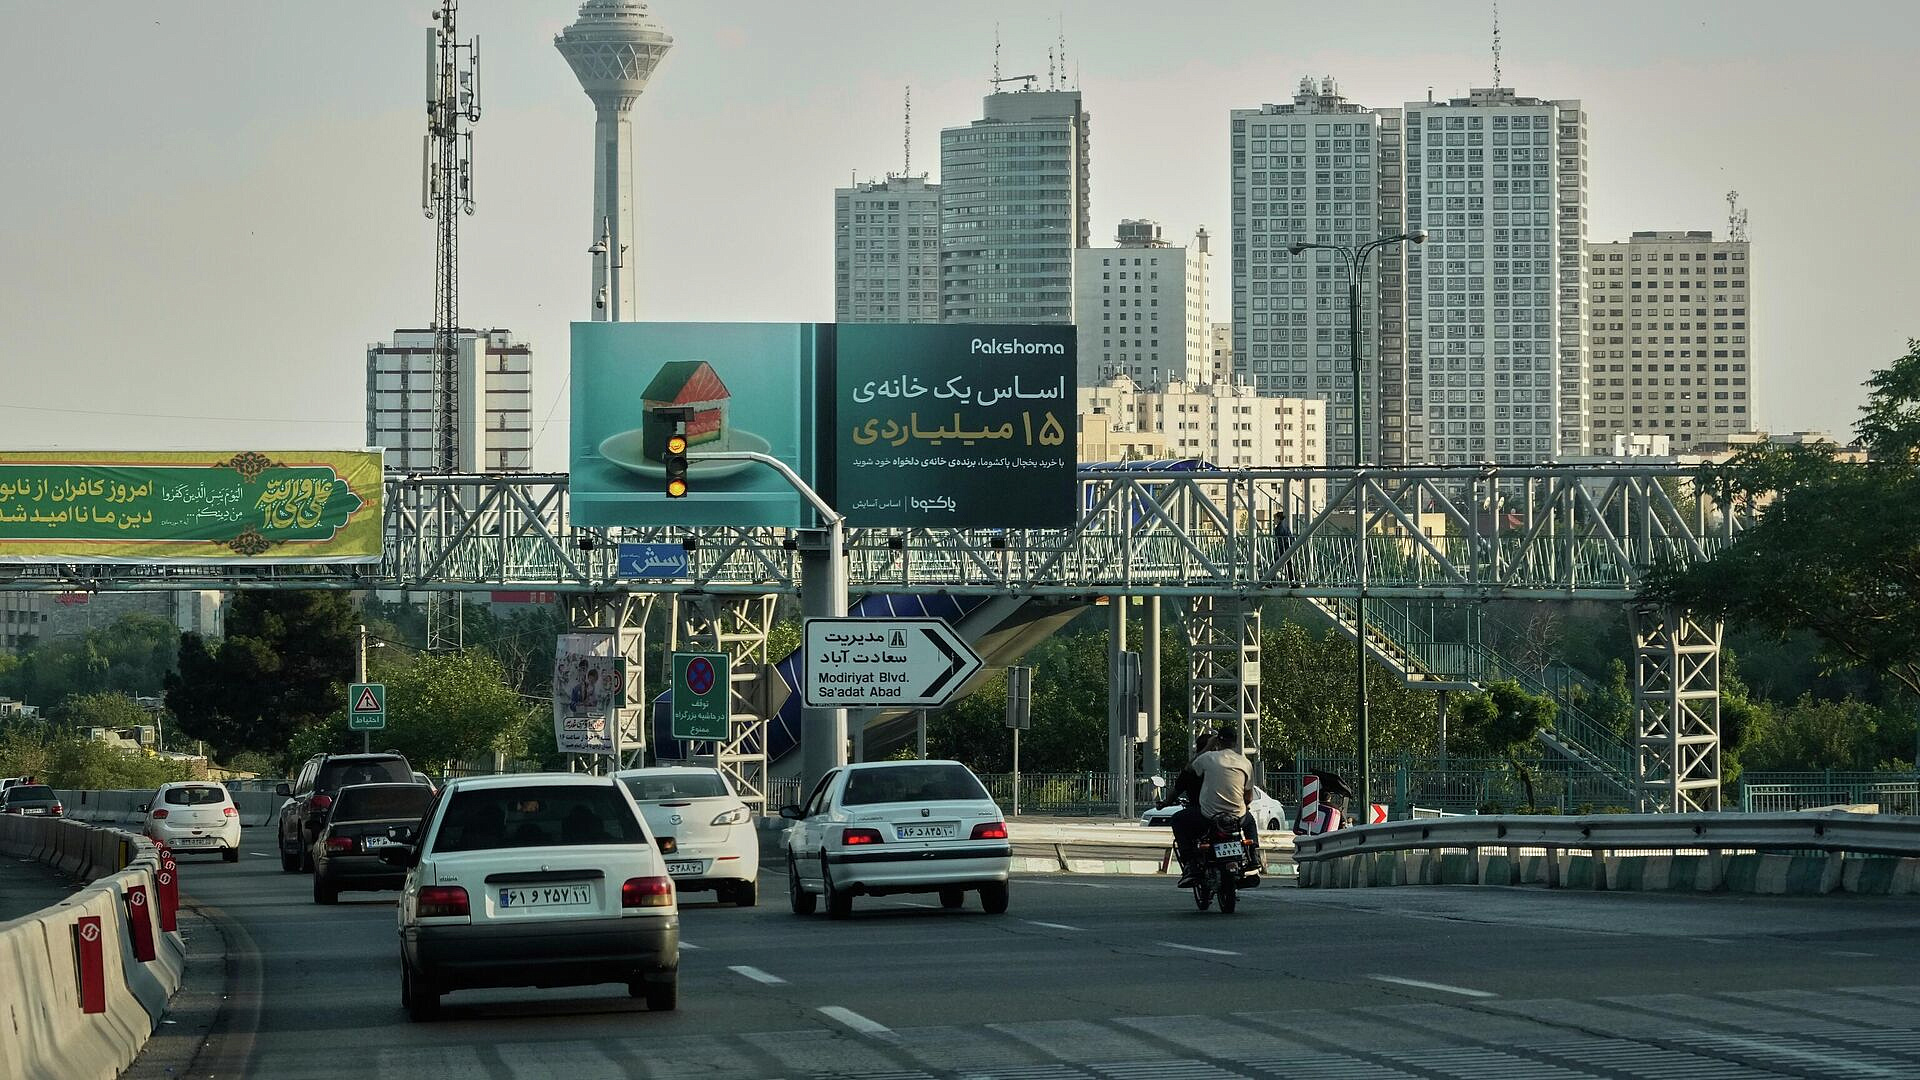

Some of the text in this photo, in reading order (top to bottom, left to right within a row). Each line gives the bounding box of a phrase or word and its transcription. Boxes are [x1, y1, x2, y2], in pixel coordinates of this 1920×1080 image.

[971, 338, 1065, 354] Pakshoma
[933, 375, 971, 404] یک
[977, 375, 1065, 406] اساس
[853, 411, 1065, 447] ۱۵ میلیاردی
[852, 457, 873, 468] شوید
[874, 457, 891, 468] خود
[893, 456, 919, 467] دلخواه
[1011, 457, 1037, 469] یخچال
[1038, 457, 1057, 469] خرید
[1057, 457, 1065, 468] با
[32, 478, 48, 502] از
[51, 477, 105, 502] کافران
[105, 479, 153, 503] امروز
[852, 498, 901, 510] اساس آسایش
[92, 505, 116, 523] ما
[118, 509, 153, 529] دین
[824, 631, 885, 646] مدیریت
[820, 649, 907, 667] سعادت آباد
[818, 672, 910, 685] Modiriyat Blvd.
[818, 686, 901, 697] Sa'adat Abad
[691, 699, 710, 710] توقف
[355, 715, 380, 725] احتیاط
[697, 711, 716, 721] حاشیه
[716, 714, 725, 722] در
[690, 726, 710, 735] ممنوع
[509, 890, 526, 905] ۶۱
[543, 887, 569, 904] ۲۵۷
[573, 889, 588, 903] ۱۱
